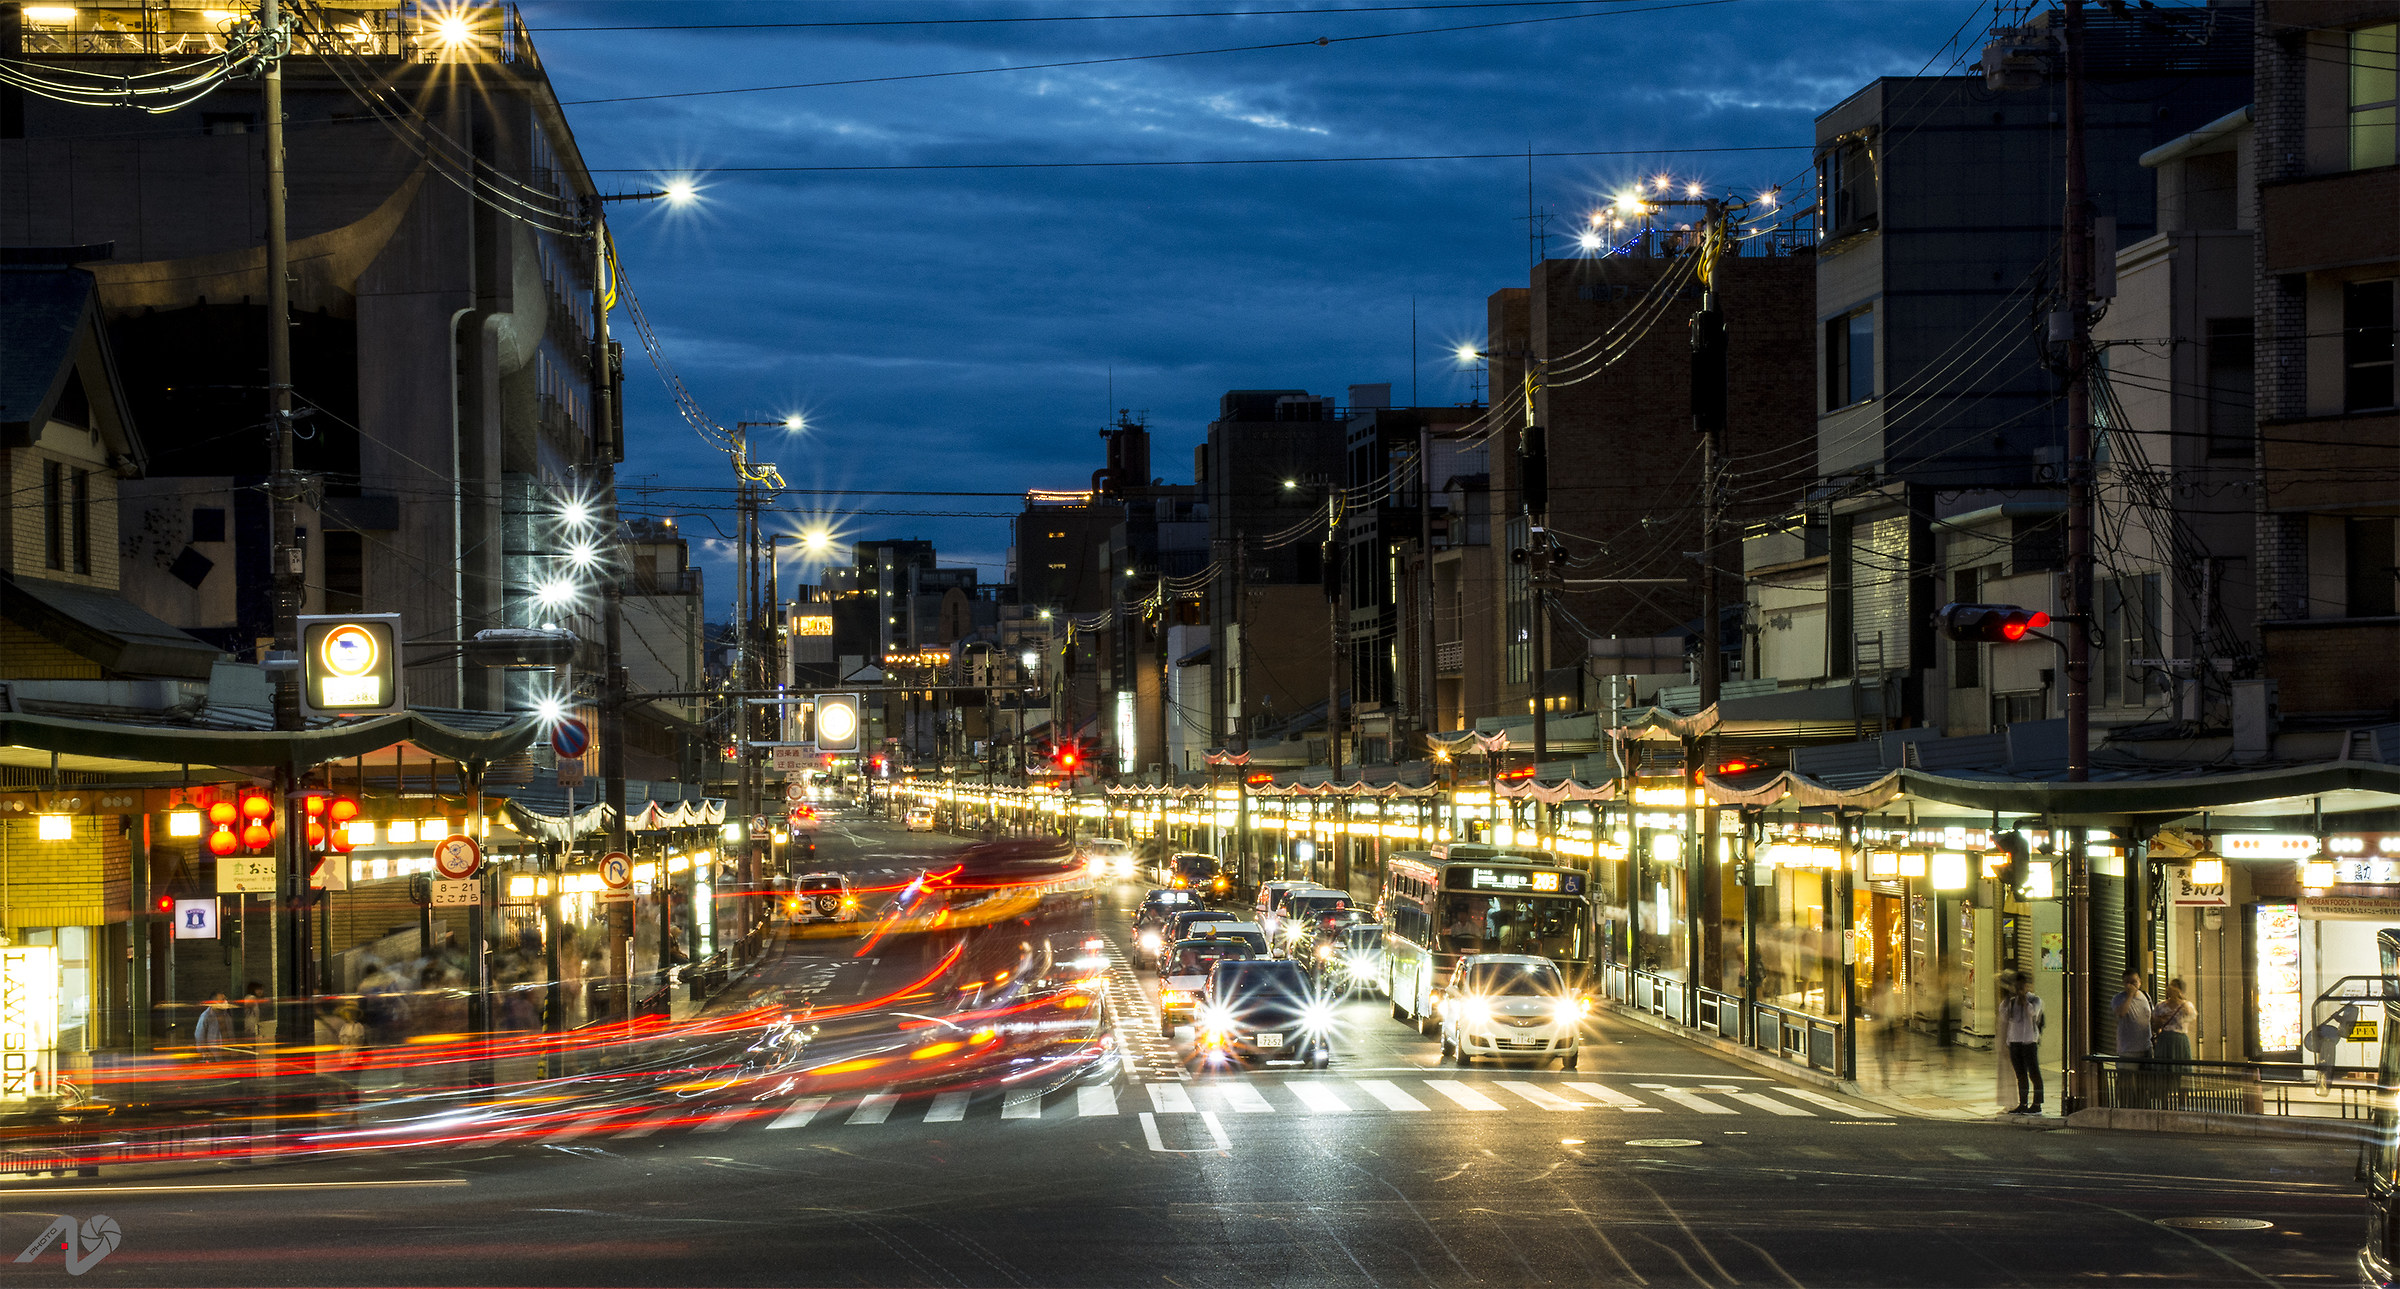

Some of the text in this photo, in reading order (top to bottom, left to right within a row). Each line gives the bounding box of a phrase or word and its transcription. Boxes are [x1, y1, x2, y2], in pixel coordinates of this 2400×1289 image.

[1533, 873, 1558, 890] 203
[436, 894, 479, 903] ここから
[2330, 898, 2350, 906] FOODS
[2358, 899, 2373, 907] More
[3, 953, 27, 1097] LAWSON
